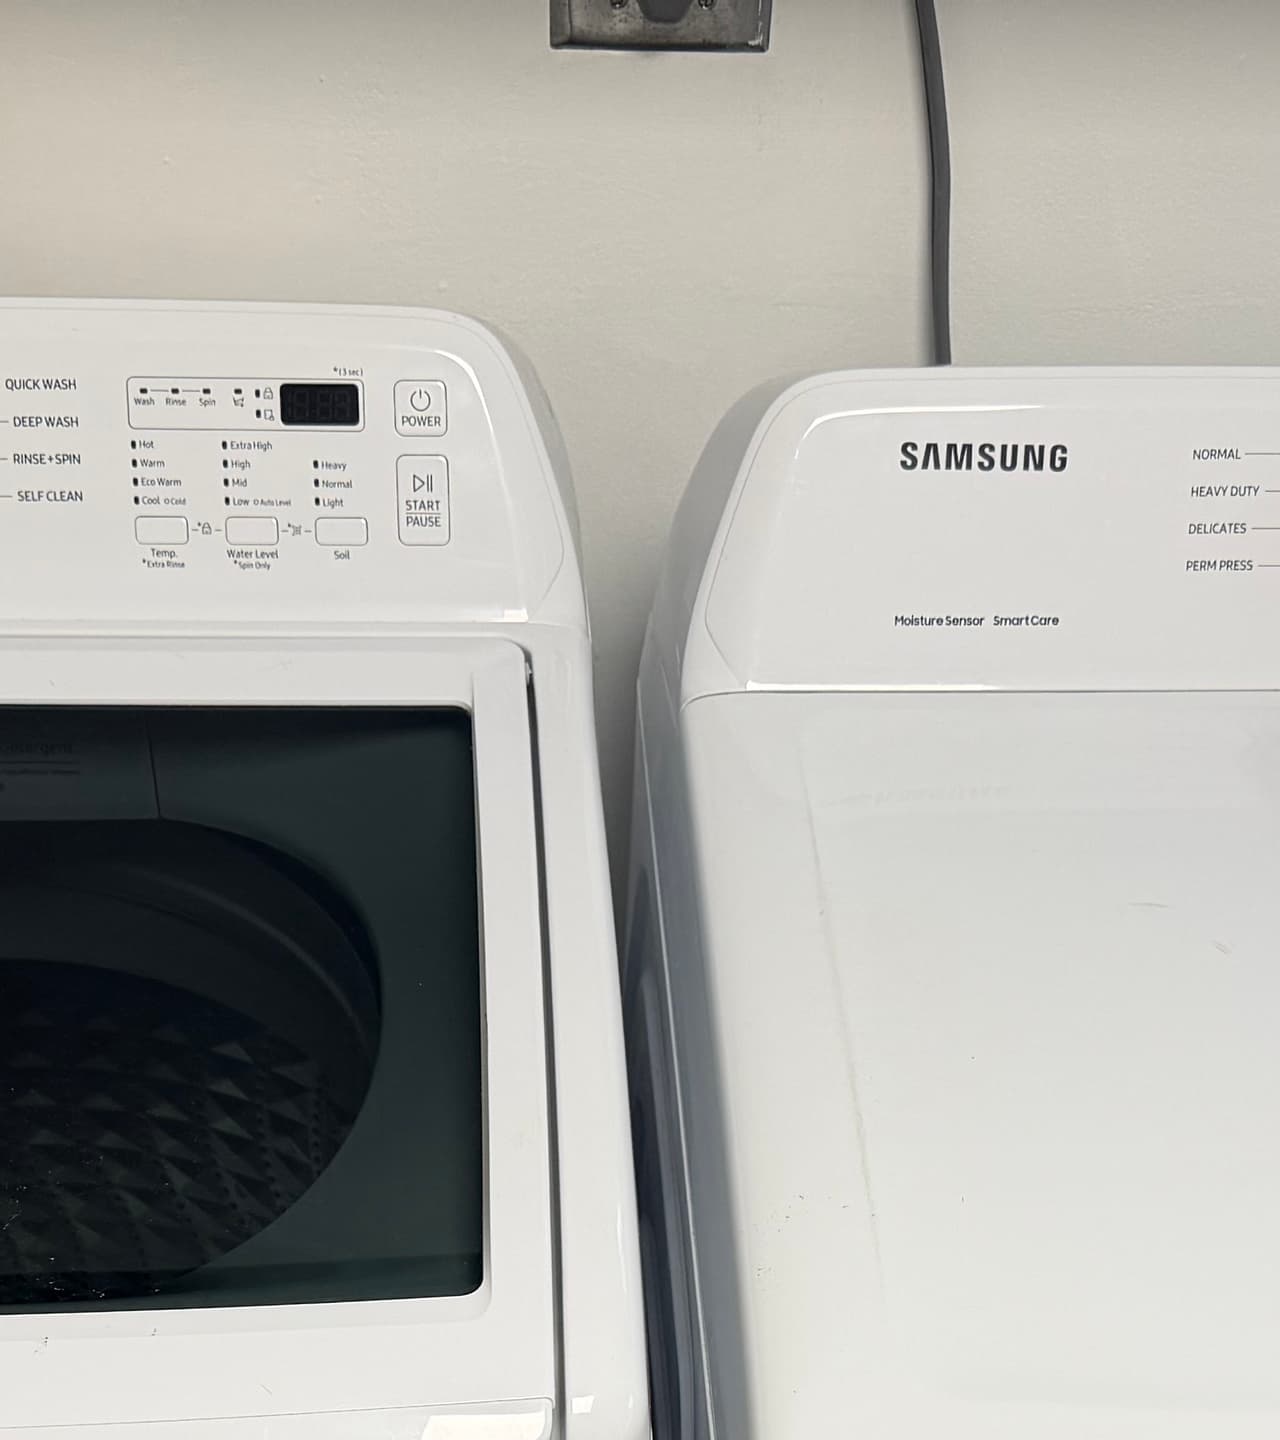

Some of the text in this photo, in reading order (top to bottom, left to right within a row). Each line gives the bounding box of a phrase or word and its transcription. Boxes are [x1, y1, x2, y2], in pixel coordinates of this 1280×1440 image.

[5, 379, 77, 391] QUICK WASH
[134, 397, 155, 405] Wash
[166, 397, 186, 406] Rinse
[199, 398, 216, 407] Spin
[13, 416, 79, 427] DEEP WASH
[402, 416, 441, 426] POWER
[139, 440, 154, 449] Hot
[231, 441, 272, 452] Extra High
[900, 442, 1068, 472] SAMSUNG
[1193, 448, 1241, 460] NORMAL
[140, 459, 165, 467] Warm
[231, 460, 251, 470] High
[321, 461, 347, 471] Heavy
[141, 477, 182, 486] Eco Warm
[232, 478, 248, 487] Mid
[322, 480, 352, 488] Normal
[18, 491, 83, 502] SELF CLEAN
[1191, 485, 1260, 498] HEAVY DUTY
[142, 496, 160, 505] Cool
[233, 497, 249, 506] Low
[323, 498, 343, 509] Light
[406, 500, 440, 511] START
[406, 516, 441, 527] PAUSE
[1188, 522, 1247, 535] DELICATES
[151, 548, 178, 559] Temp.
[227, 549, 278, 559] Water Level
[334, 550, 350, 560] Soil
[255, 561, 271, 571] Only
[1186, 560, 1253, 572] PERM PRESS
[895, 615, 1059, 626] Moisture Sensor SmartCare
